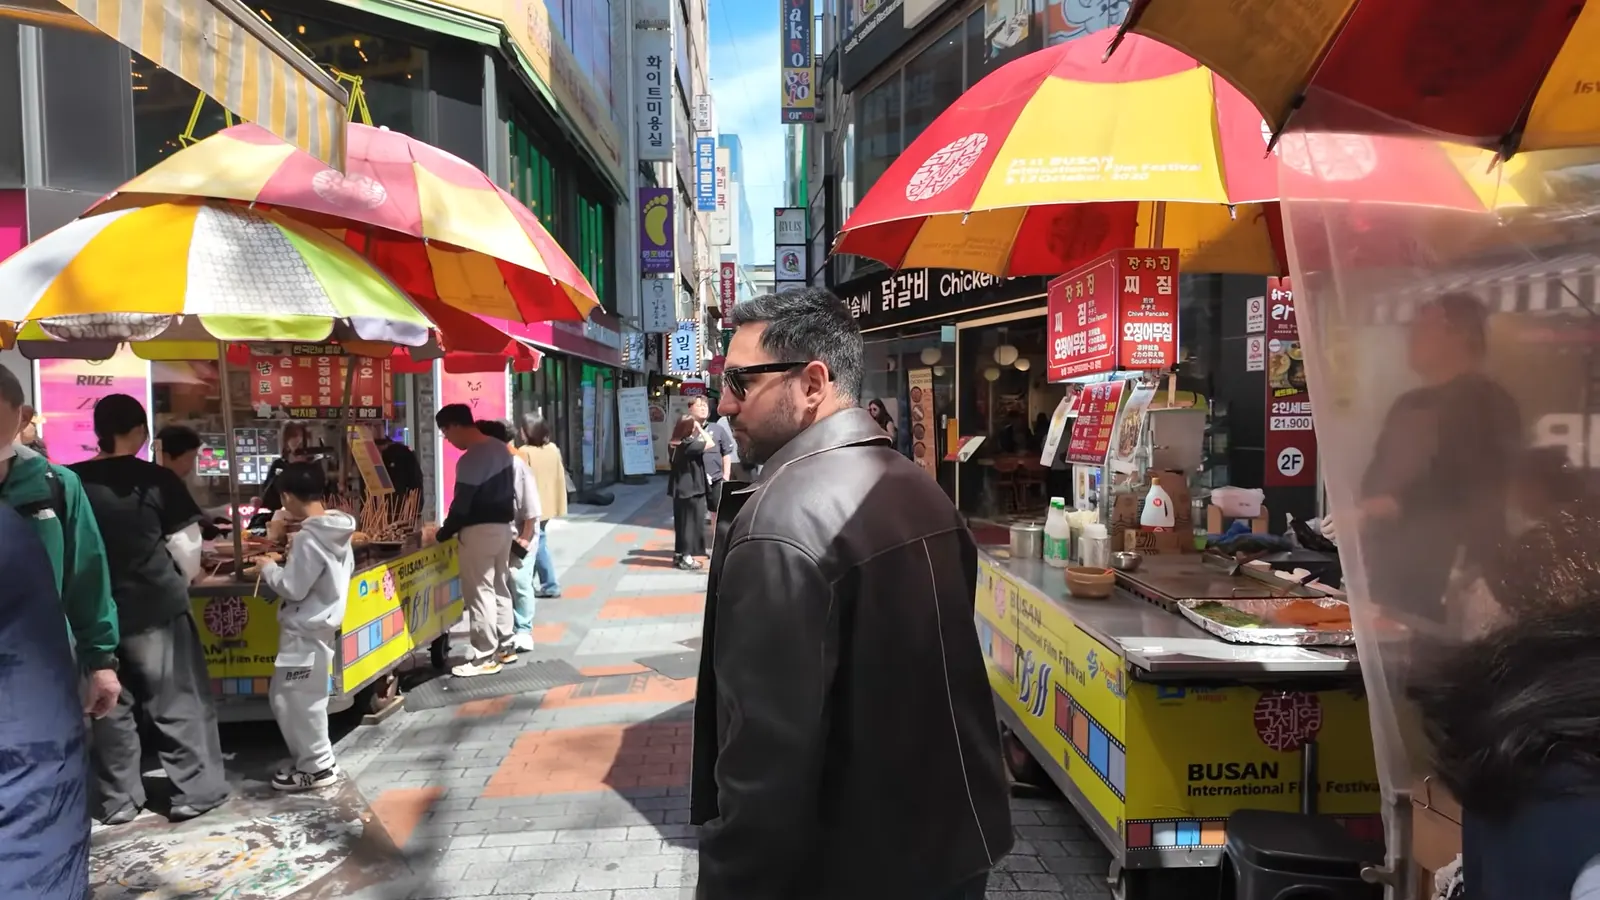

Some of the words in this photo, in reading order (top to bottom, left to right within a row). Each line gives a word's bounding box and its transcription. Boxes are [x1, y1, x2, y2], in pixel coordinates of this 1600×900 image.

[645, 55, 663, 147] 화이트미용실
[881, 267, 929, 312] 닭갈비
[1123, 322, 1173, 343] 오징어무침
[676, 334, 690, 371] 밀면
[76, 374, 115, 387] RIIZE
[1274, 418, 1310, 429] 21,900
[1280, 454, 1302, 470] 2F
[1187, 762, 1279, 781] BUSAN
[1187, 783, 1284, 797] International
